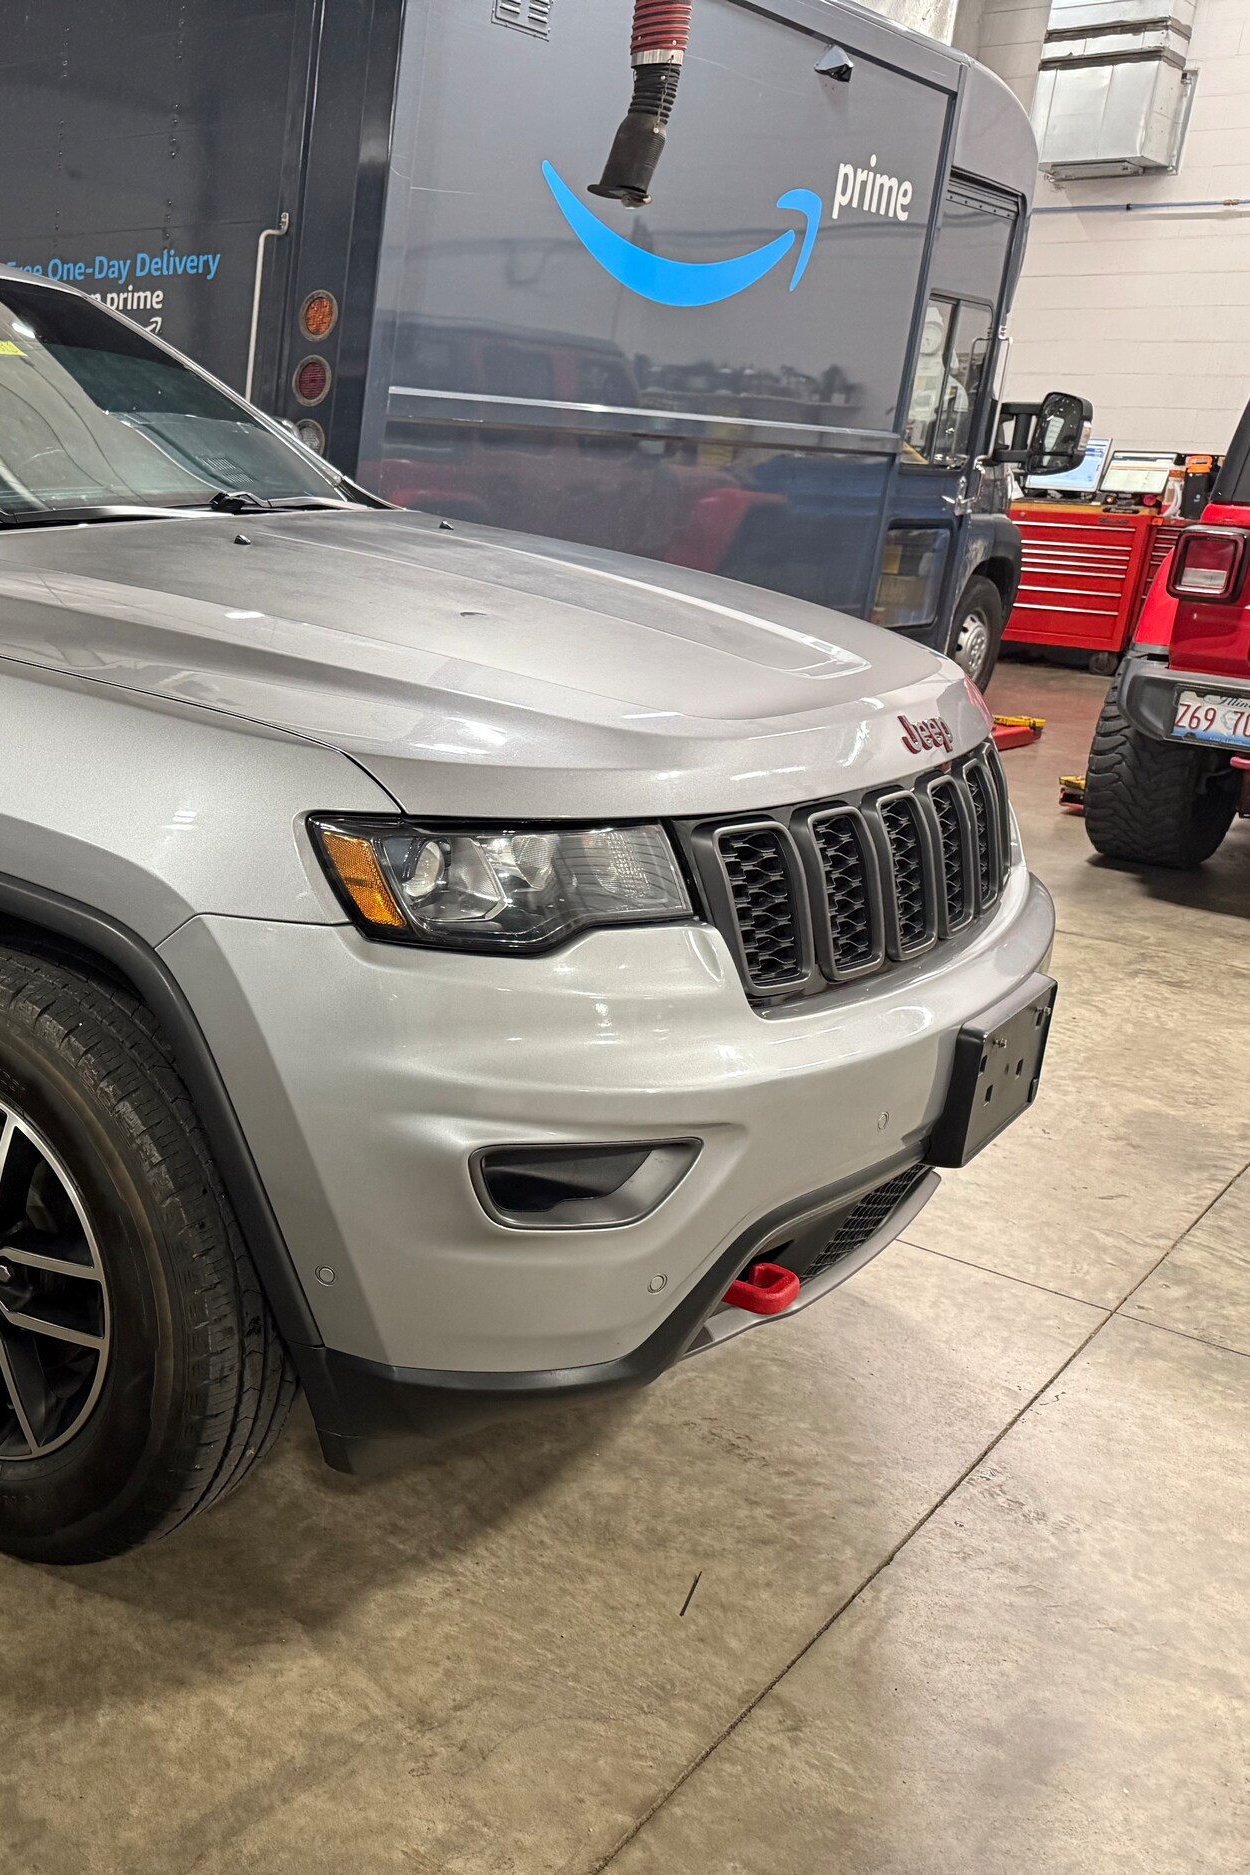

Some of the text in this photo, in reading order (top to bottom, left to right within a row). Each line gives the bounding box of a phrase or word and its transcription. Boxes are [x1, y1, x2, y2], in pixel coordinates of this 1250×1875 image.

[831, 154, 913, 222] prime
[48, 255, 131, 285] One-Day
[136, 248, 221, 281] Delivery
[106, 284, 164, 311] prime
[897, 714, 954, 755] Jeep
[1174, 703, 1217, 732] Z69
